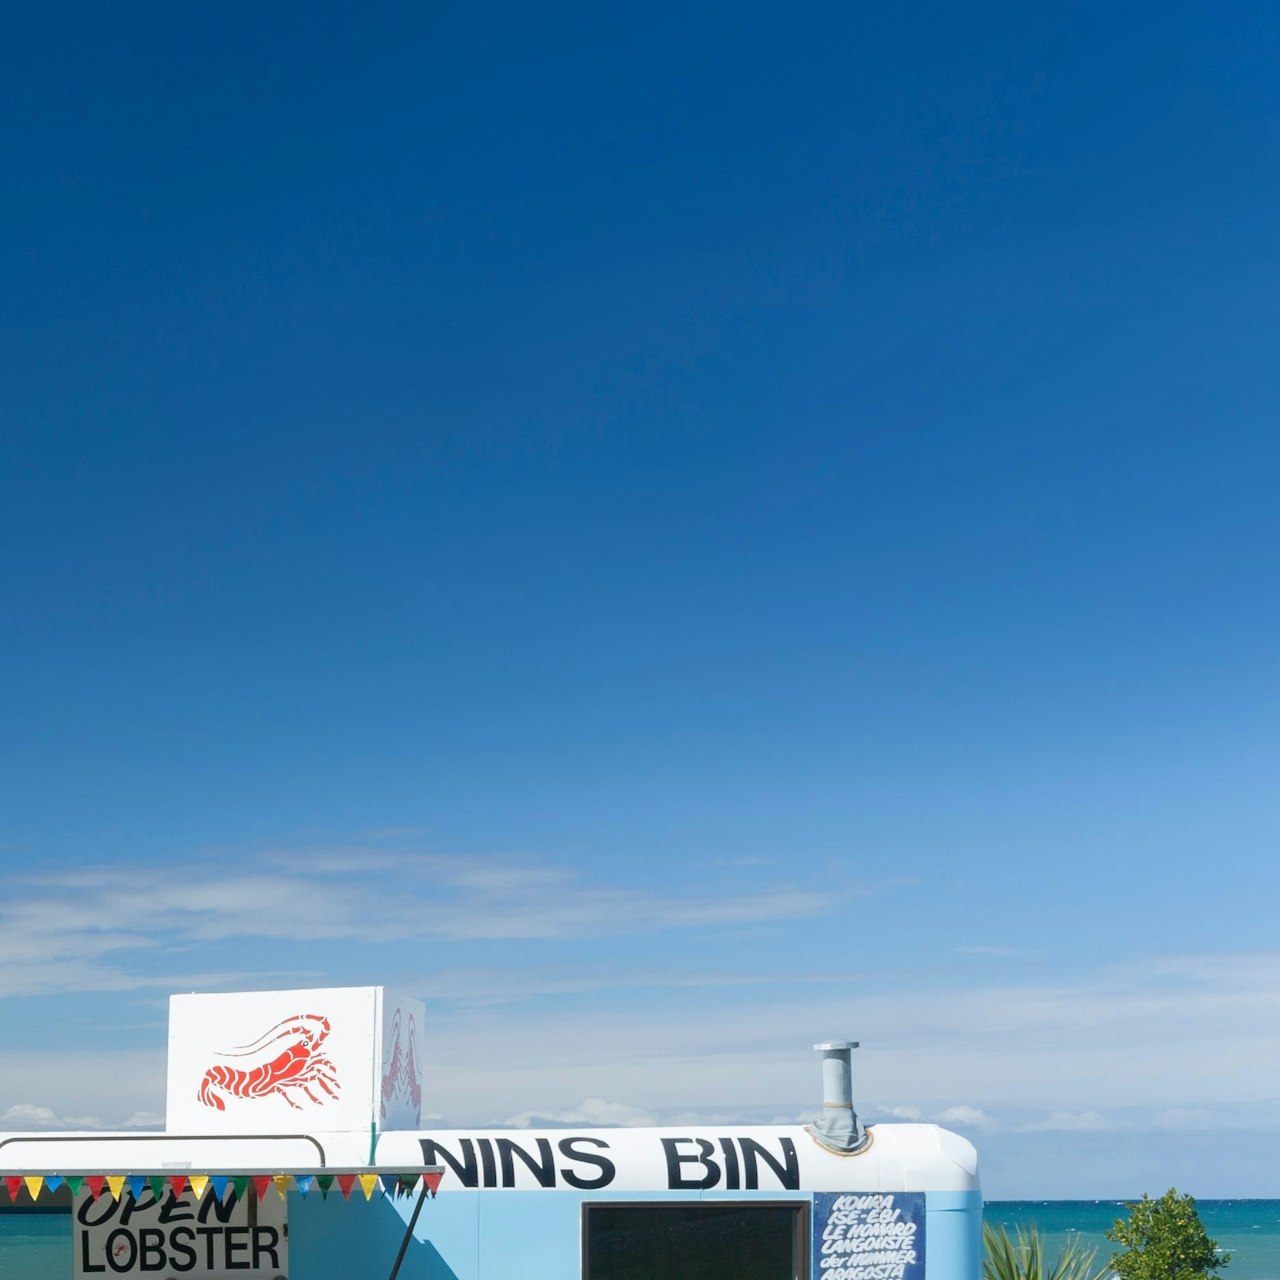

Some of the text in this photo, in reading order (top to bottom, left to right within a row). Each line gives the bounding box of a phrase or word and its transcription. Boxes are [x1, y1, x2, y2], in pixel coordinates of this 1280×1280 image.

[418, 1136, 801, 1191] NINS BIN
[77, 1185, 242, 1227] OPEN
[832, 1195, 895, 1211] KOURA
[827, 1208, 902, 1225] ISE-EBI
[822, 1222, 917, 1241] LE HOMARD
[81, 1226, 280, 1273] LOBSTER
[821, 1235, 916, 1254] LANGOUSTE
[820, 1250, 917, 1268] der HUMMER
